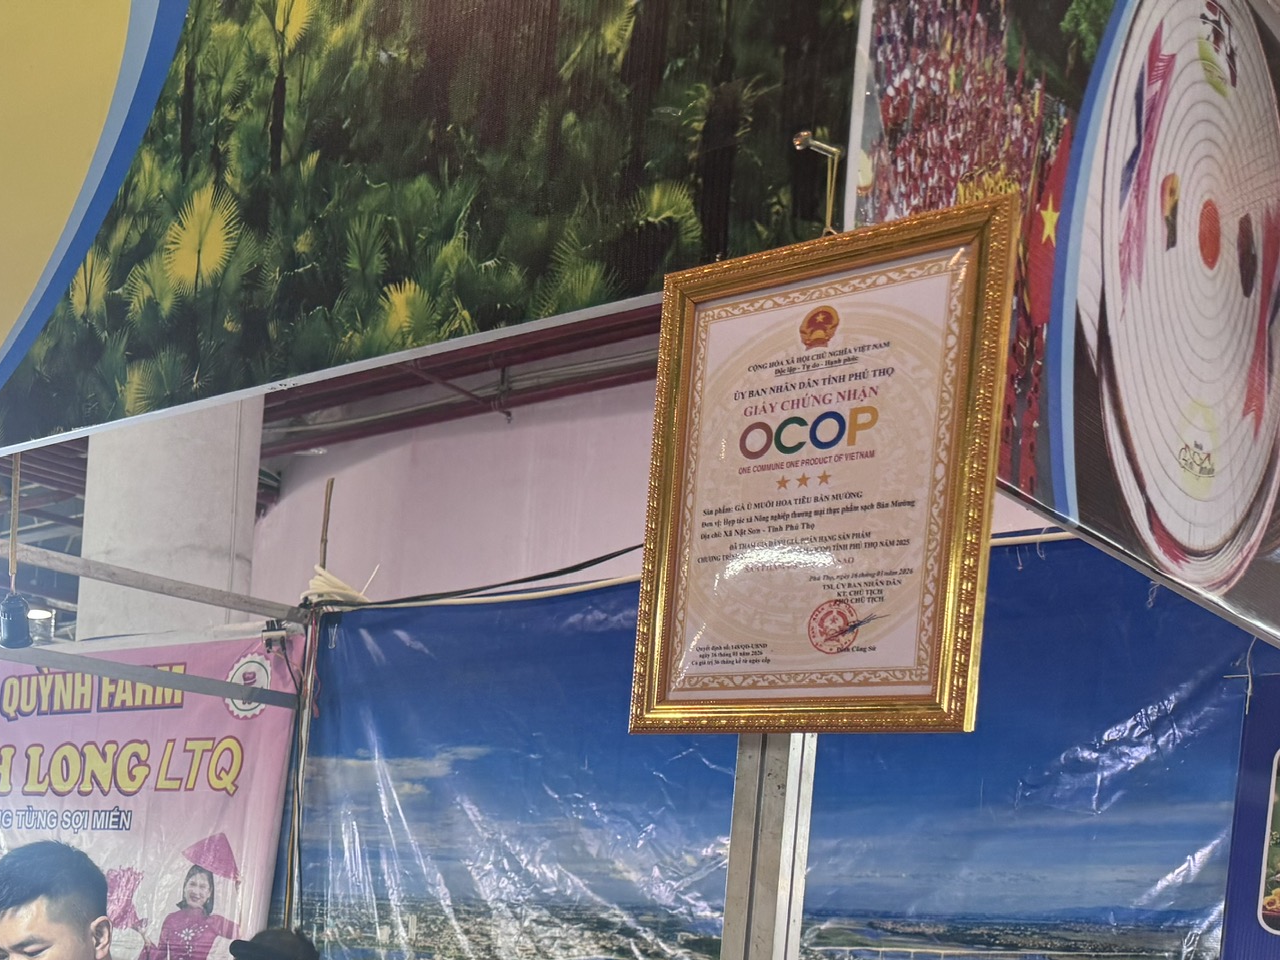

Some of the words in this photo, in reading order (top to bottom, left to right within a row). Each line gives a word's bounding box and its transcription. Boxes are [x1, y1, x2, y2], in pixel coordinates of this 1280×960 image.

[871, 341, 891, 351] NAM
[733, 389, 747, 401] ỦY
[748, 387, 768, 398] BAN
[769, 382, 797, 394] NHÂN
[798, 378, 819, 390] DÂN
[822, 373, 847, 386] TỈNH
[848, 369, 870, 381] PHÚ
[871, 366, 895, 379] THỌ
[743, 400, 779, 417] GIẤY
[780, 392, 832, 411] CHỨNG
[836, 385, 880, 404] NHẬN
[739, 405, 880, 460] OCOP
[738, 466, 751, 475] ONE
[752, 462, 785, 473] COMMUNE
[786, 459, 799, 469] ONE
[800, 456, 832, 467] PRODUCT
[833, 453, 844, 463] OF
[845, 449, 876, 461] VIETNAM
[0, 665, 95, 722] QUỲNH
[21, 739, 151, 797] LONG
[154, 735, 244, 797] LTQ
[15, 805, 59, 831] TỪNG
[60, 807, 89, 834] SỢI
